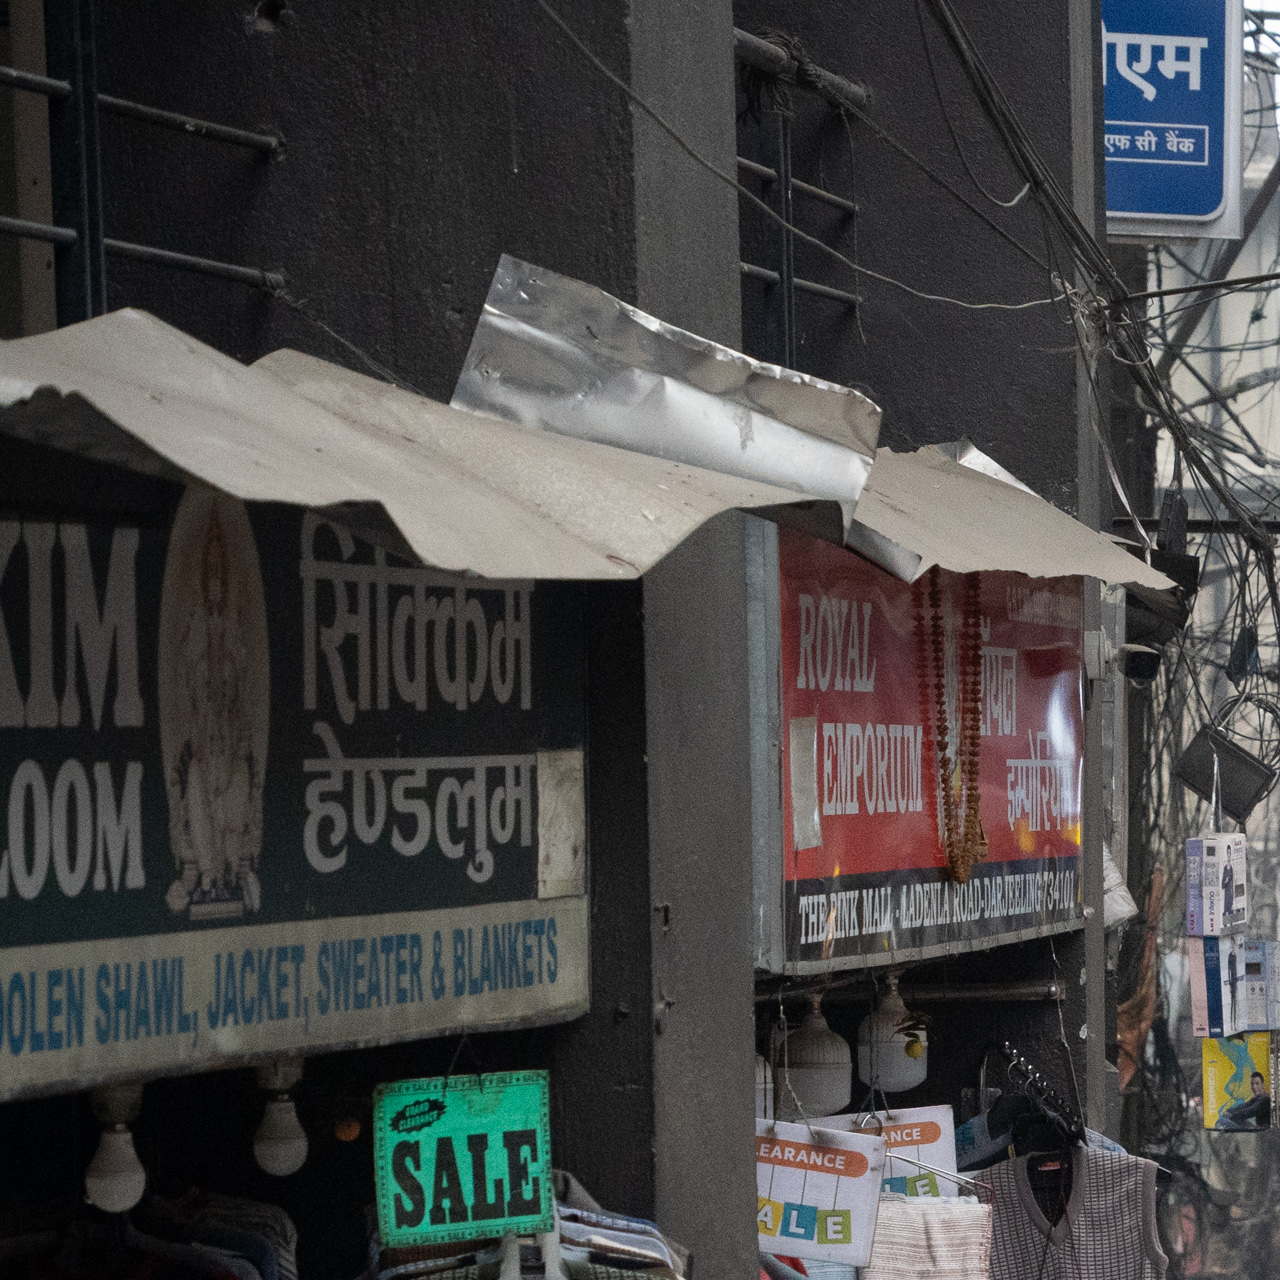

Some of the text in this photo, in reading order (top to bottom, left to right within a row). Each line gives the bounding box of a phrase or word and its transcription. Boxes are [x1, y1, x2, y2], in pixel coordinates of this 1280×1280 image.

[1135, 130, 1158, 152] सी
[1164, 129, 1196, 153] बैंक
[797, 593, 877, 692] ROYAL
[822, 722, 924, 816] EMPORIUM
[0, 758, 147, 900] OOM
[799, 894, 827, 945] THE
[861, 886, 892, 935] MALL
[900, 881, 951, 929] LADENLA
[95, 955, 200, 1048] SHAWL,
[316, 931, 423, 1016] SWEATER
[431, 929, 446, 1001] &
[452, 916, 559, 999] BLANKETS
[391, 1128, 543, 1230] SALE
[756, 1142, 846, 1170] EARANCE
[757, 1204, 844, 1241] ALE
